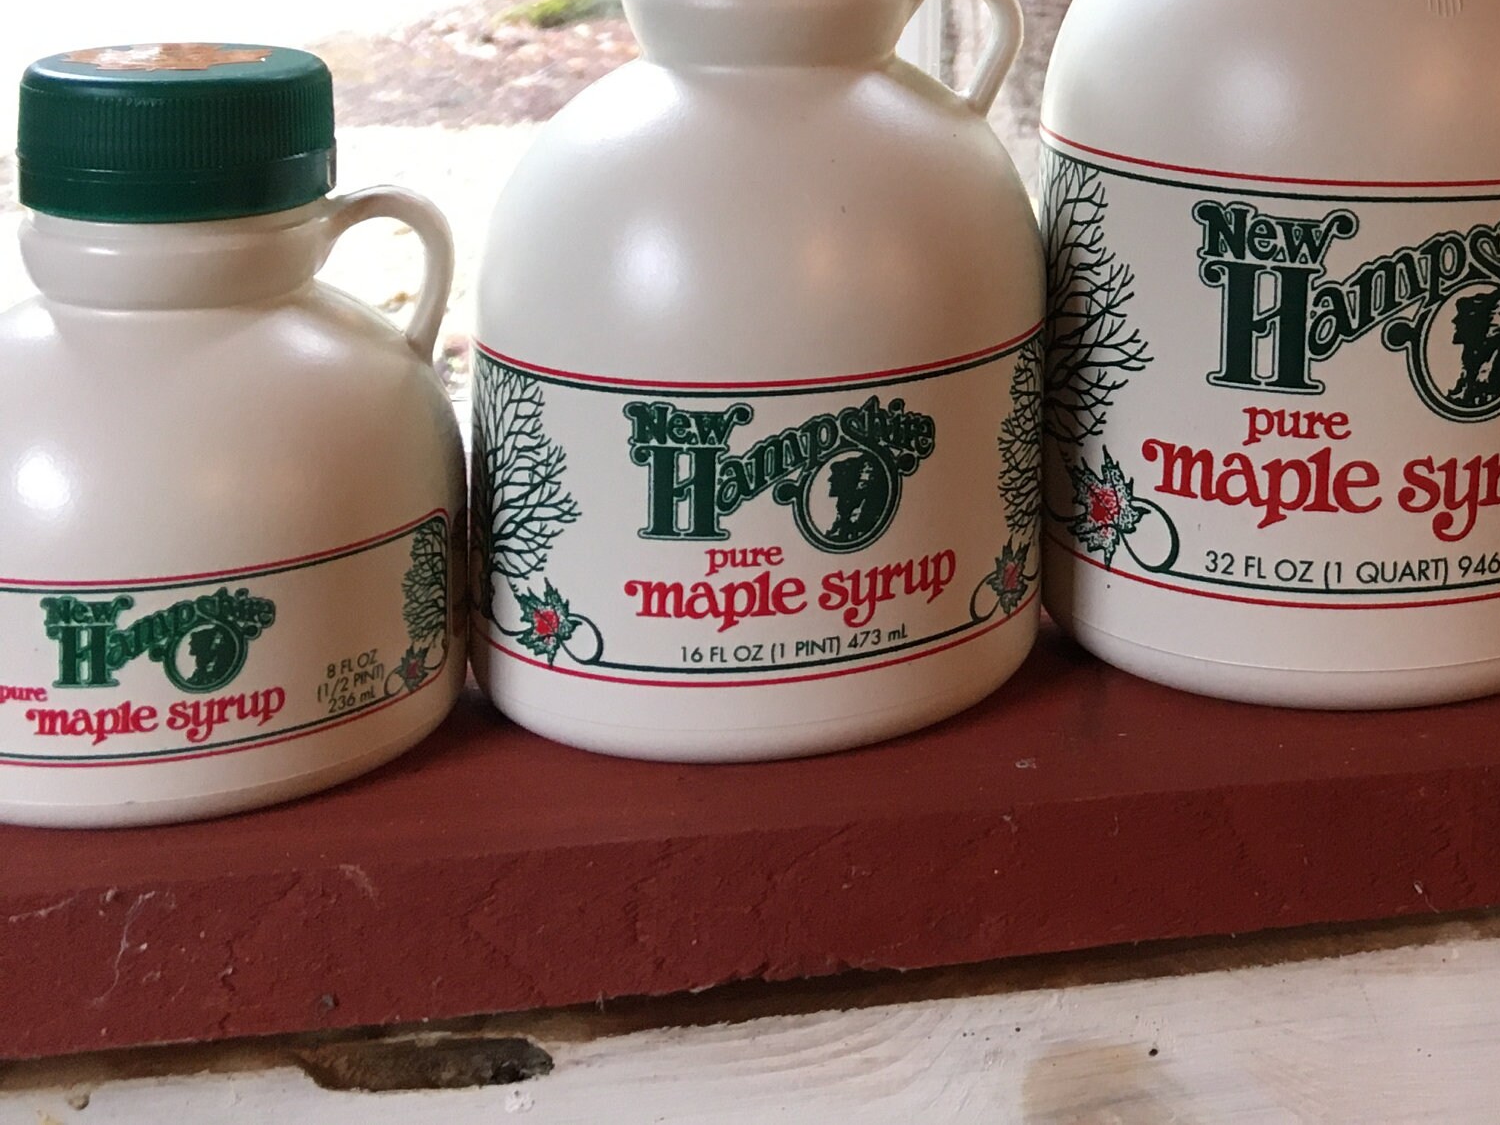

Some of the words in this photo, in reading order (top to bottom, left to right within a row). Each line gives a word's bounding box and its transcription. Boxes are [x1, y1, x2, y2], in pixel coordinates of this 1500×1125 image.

[1192, 200, 1360, 264] New
[623, 401, 754, 445] New
[1242, 405, 1352, 446] pure
[629, 395, 936, 554] Hampshire
[1141, 438, 1382, 529] maple
[705, 546, 784, 575] pure
[1204, 551, 1235, 577] 32
[1243, 555, 1267, 580] FL
[1274, 558, 1314, 583] OZ
[1323, 558, 1344, 588] (1
[1355, 556, 1448, 585] QUART)
[40, 596, 134, 625] New
[624, 571, 808, 633] maple
[819, 549, 956, 627] syrup
[46, 587, 276, 693] Hampshire
[681, 646, 704, 663] 16
[709, 645, 729, 663] FL
[733, 643, 765, 662] OZ
[771, 642, 786, 664] (1
[794, 637, 840, 659] PINT)
[847, 630, 882, 650] 473
[0, 685, 48, 704] pure
[25, 701, 158, 745] maple
[166, 686, 286, 743] syrup
